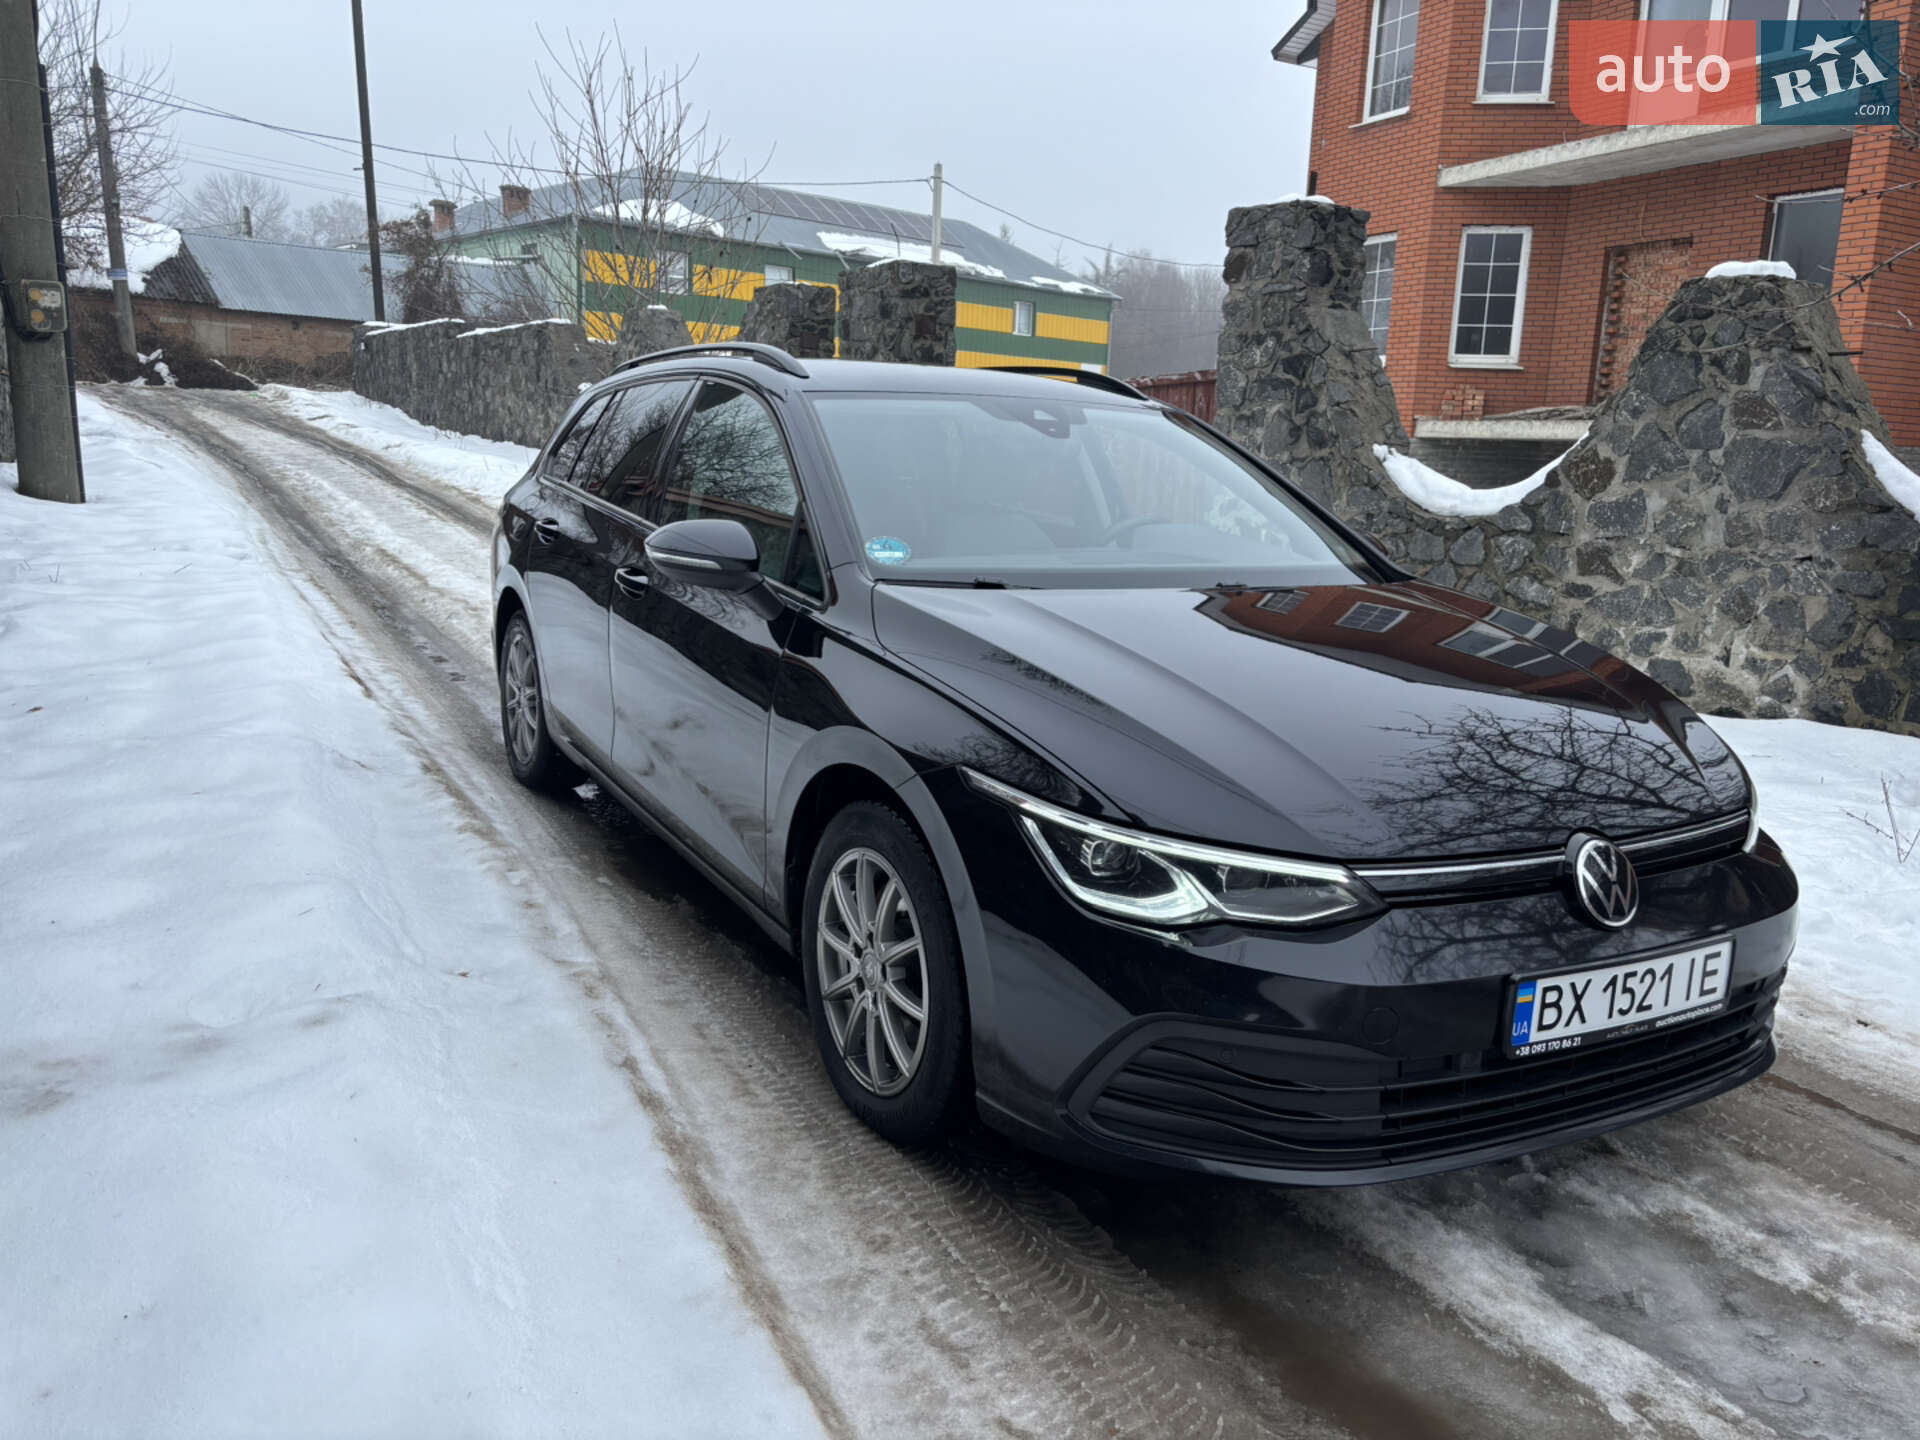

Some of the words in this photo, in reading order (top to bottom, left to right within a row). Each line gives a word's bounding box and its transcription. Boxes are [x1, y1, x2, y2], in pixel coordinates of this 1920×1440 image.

[1537, 978, 1592, 1032] BX
[1602, 963, 1674, 1020] 1521
[1686, 951, 1722, 1002] IE
[1512, 1021, 1528, 1036] UA
[1516, 1046, 1530, 1056] +38
[1531, 1043, 1546, 1054] 093
